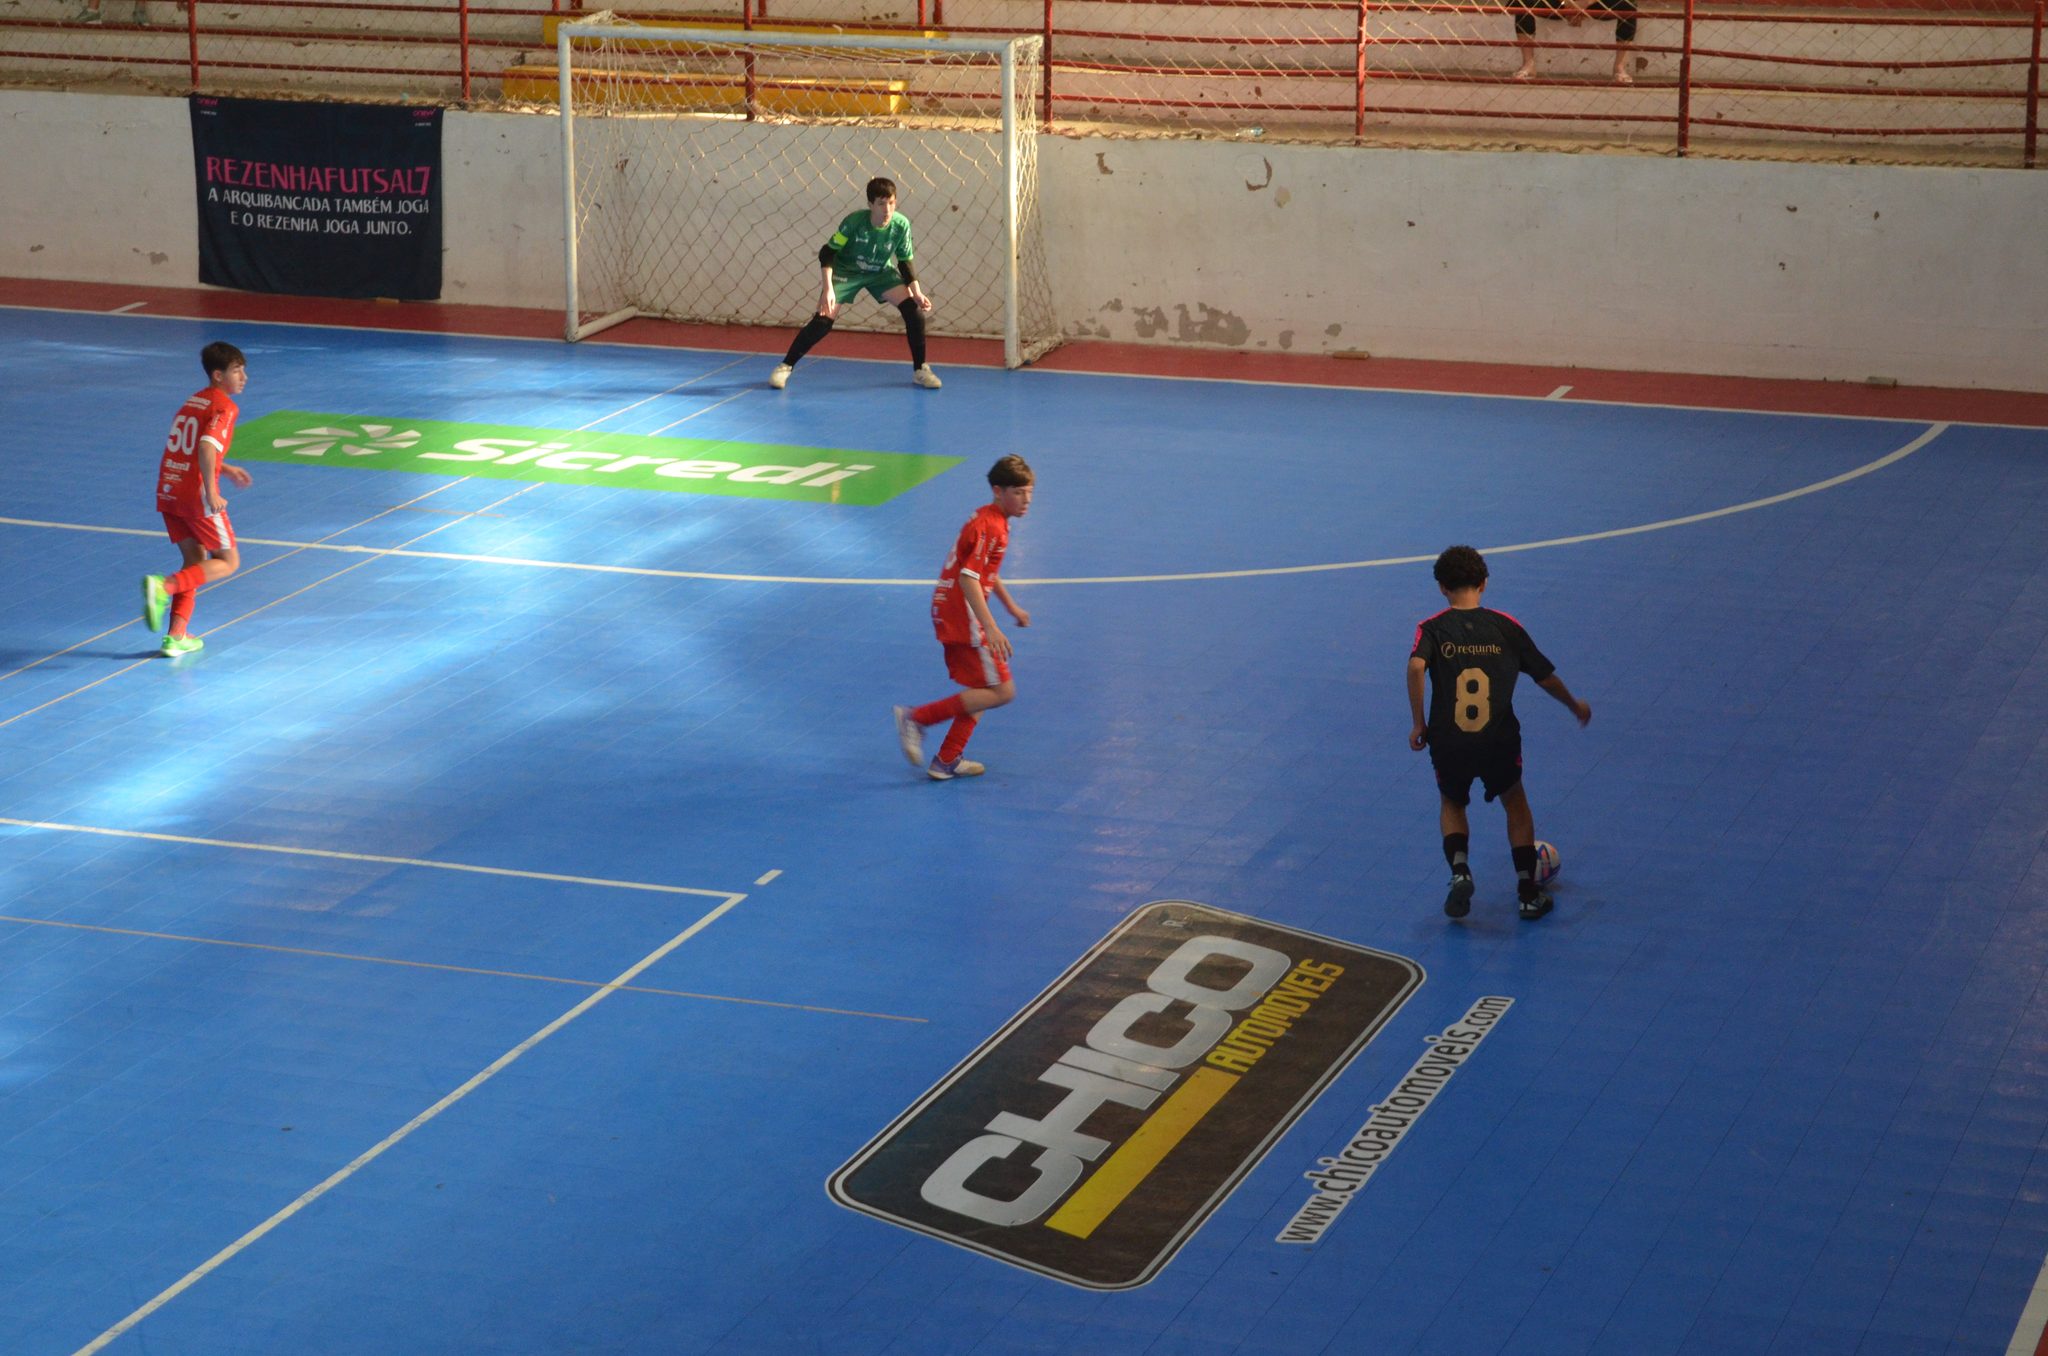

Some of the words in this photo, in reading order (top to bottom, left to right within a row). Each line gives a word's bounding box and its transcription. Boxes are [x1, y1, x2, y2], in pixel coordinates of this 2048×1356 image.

[206, 156, 431, 196] REZENHAFUTSAL7
[208, 187, 219, 202] A
[222, 189, 330, 212] ARQUIBANCADA
[334, 196, 392, 214] TAMBÉM
[395, 199, 430, 214] JOGA
[230, 211, 240, 225] E
[242, 212, 254, 227] O
[256, 214, 319, 232] REZENHA
[323, 219, 360, 234] JOGA
[363, 221, 413, 235] JUNTO.
[167, 415, 199, 456] 50
[416, 437, 876, 488] Sicredi
[1457, 643, 1502, 656] requinte
[1454, 667, 1490, 732] 8
[1205, 958, 1345, 1073] AUTOMOVEIS
[920, 935, 1292, 1227] CHICO
[1280, 996, 1510, 1242] www.chicoautomoveis.com
